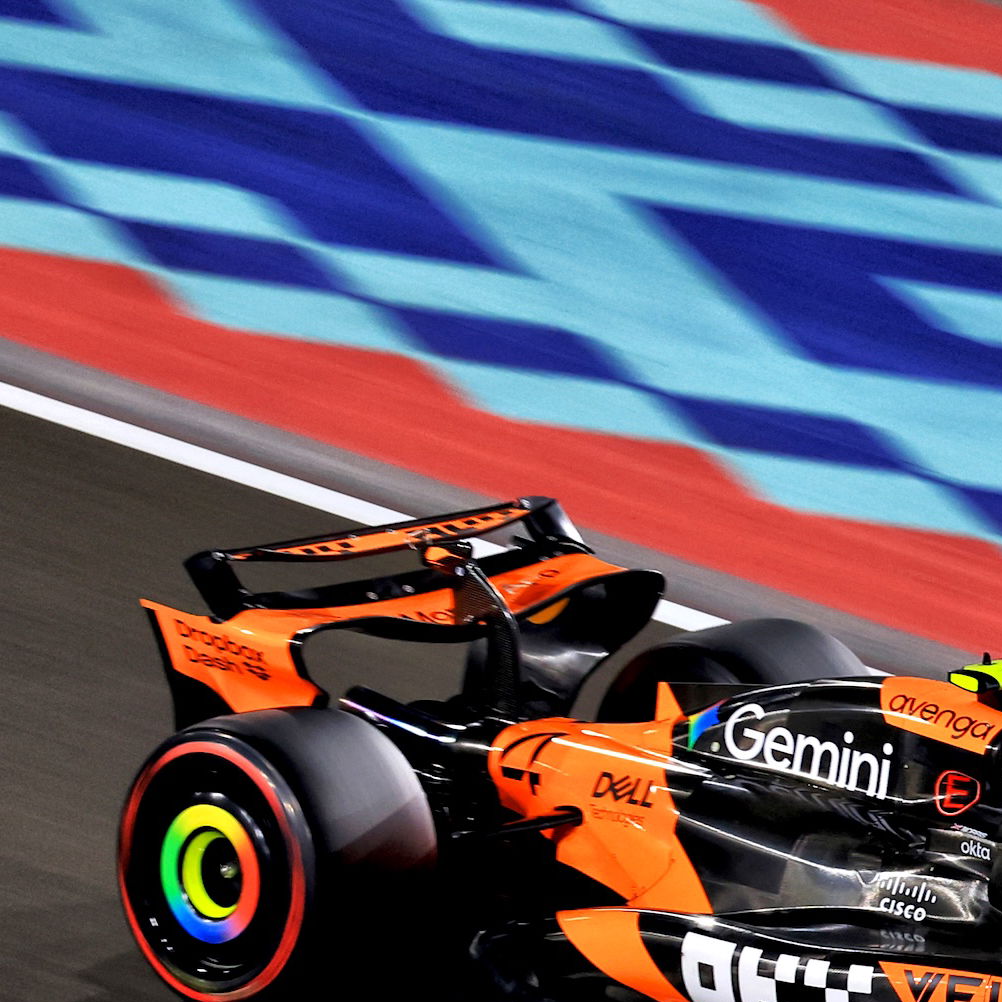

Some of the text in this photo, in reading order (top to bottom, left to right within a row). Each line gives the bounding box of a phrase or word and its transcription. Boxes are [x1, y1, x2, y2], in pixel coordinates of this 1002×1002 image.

[184, 645, 244, 674] Dash
[889, 693, 995, 740] avenga
[725, 704, 894, 799] Gemini
[592, 771, 654, 818] DELL
[960, 840, 991, 860] okta
